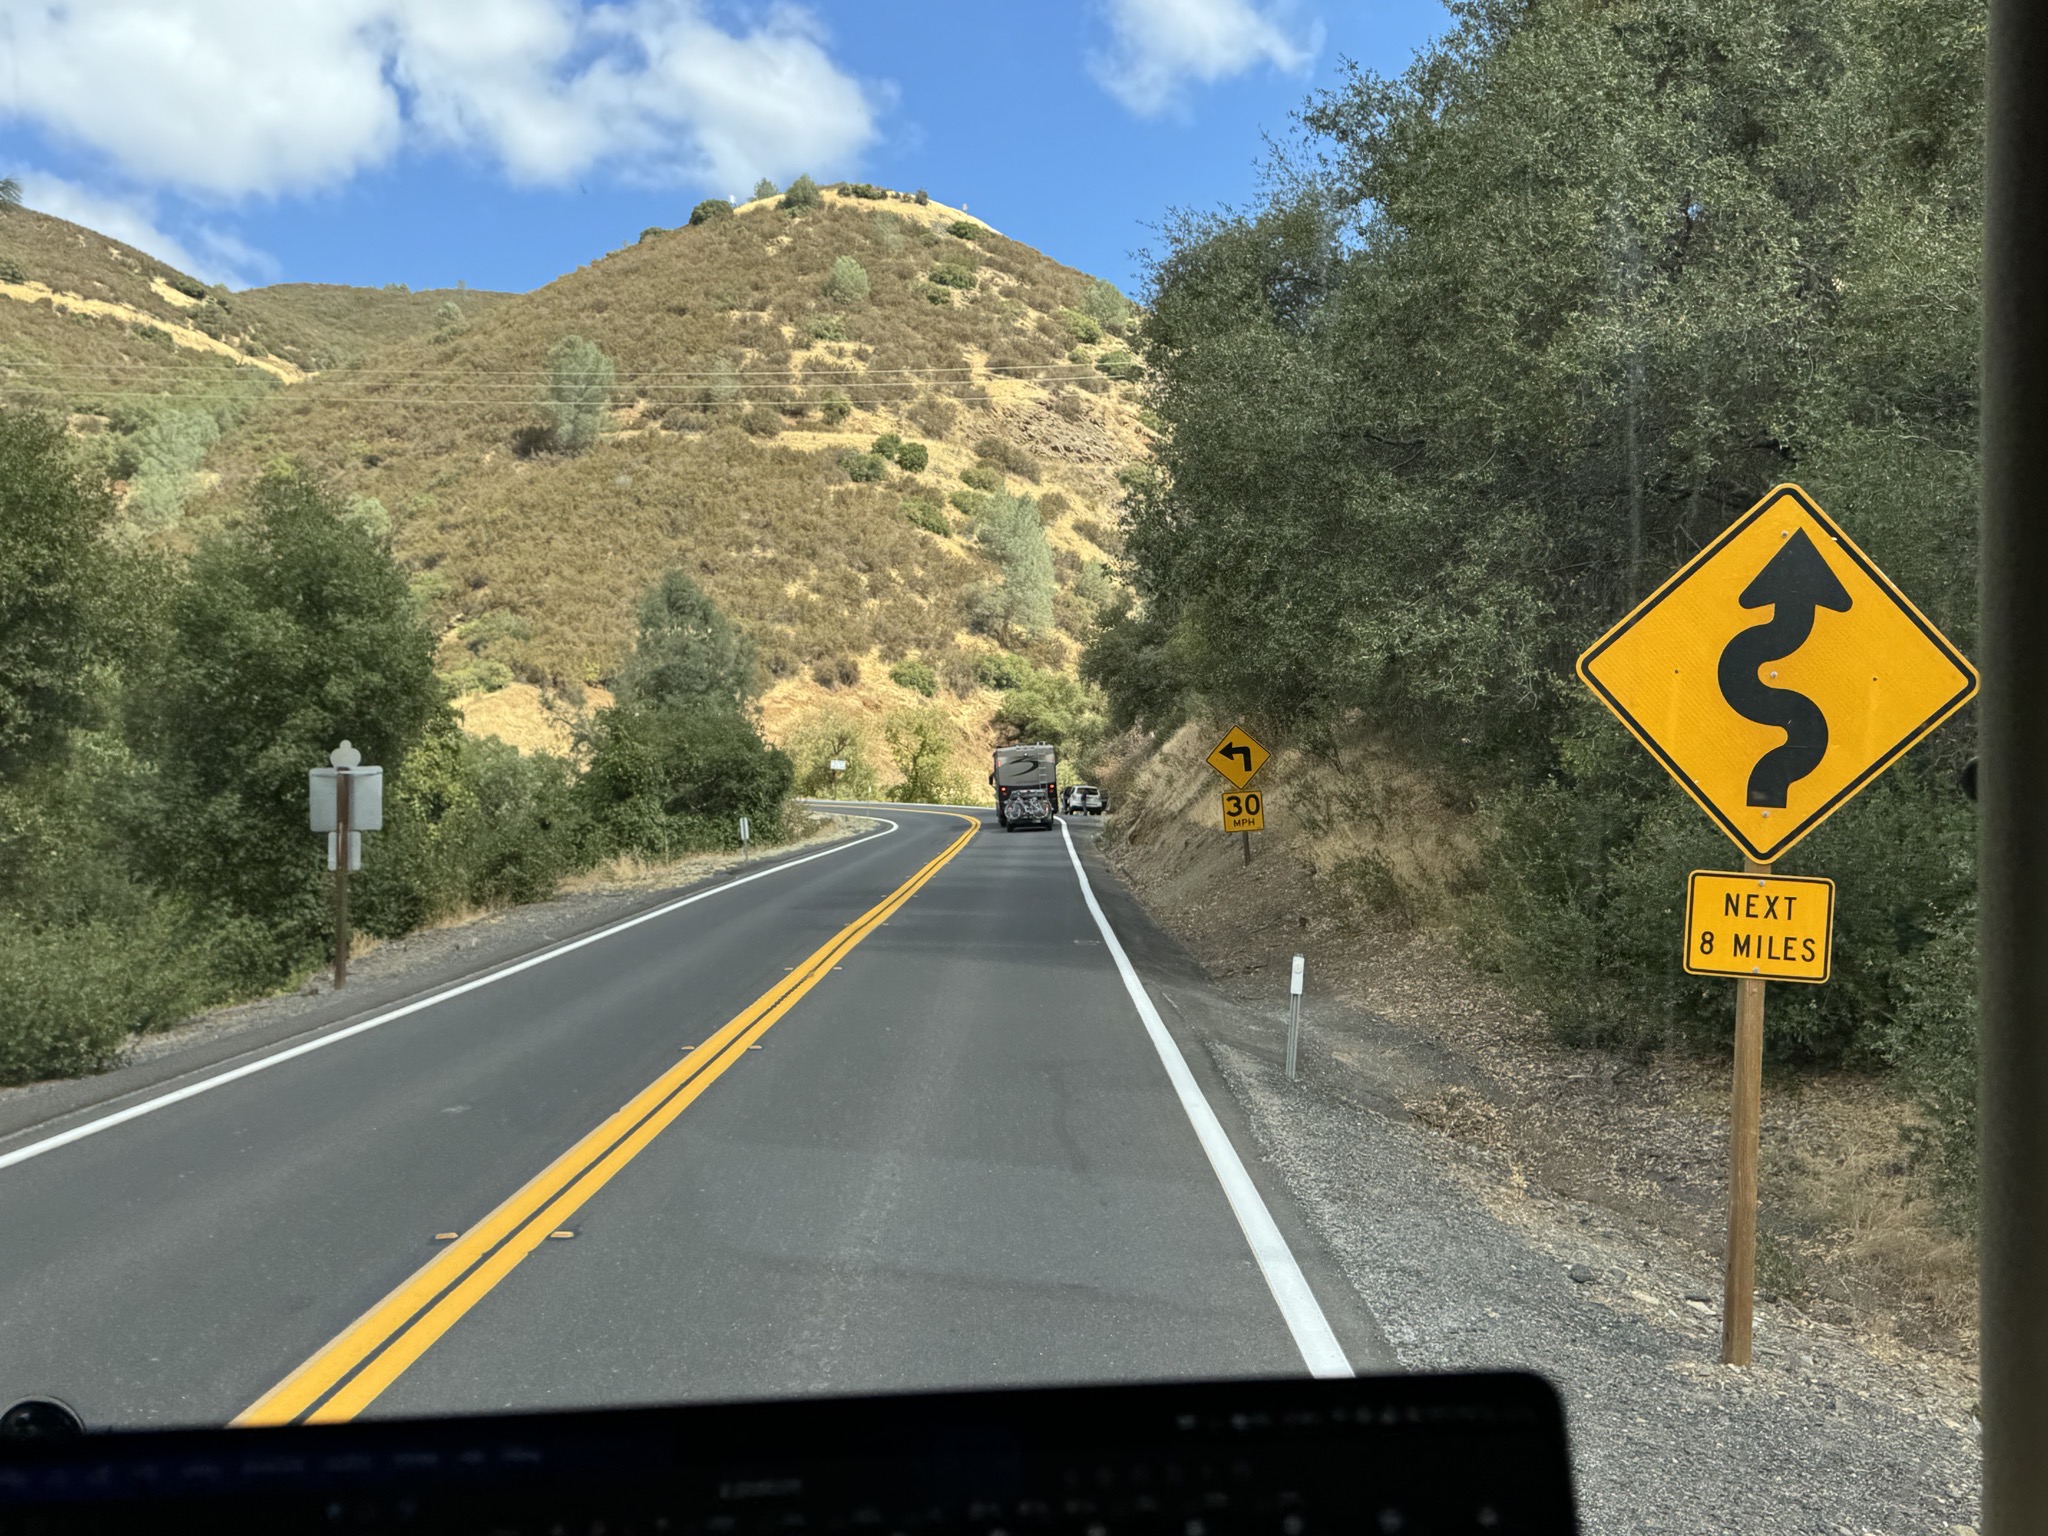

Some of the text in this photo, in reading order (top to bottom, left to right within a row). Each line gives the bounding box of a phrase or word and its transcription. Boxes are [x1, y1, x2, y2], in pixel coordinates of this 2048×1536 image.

[1226, 793, 1260, 817] 30
[1233, 818, 1255, 828] MPH
[1724, 892, 1797, 921] NEXT
[1700, 931, 1816, 962] 8 MILES
